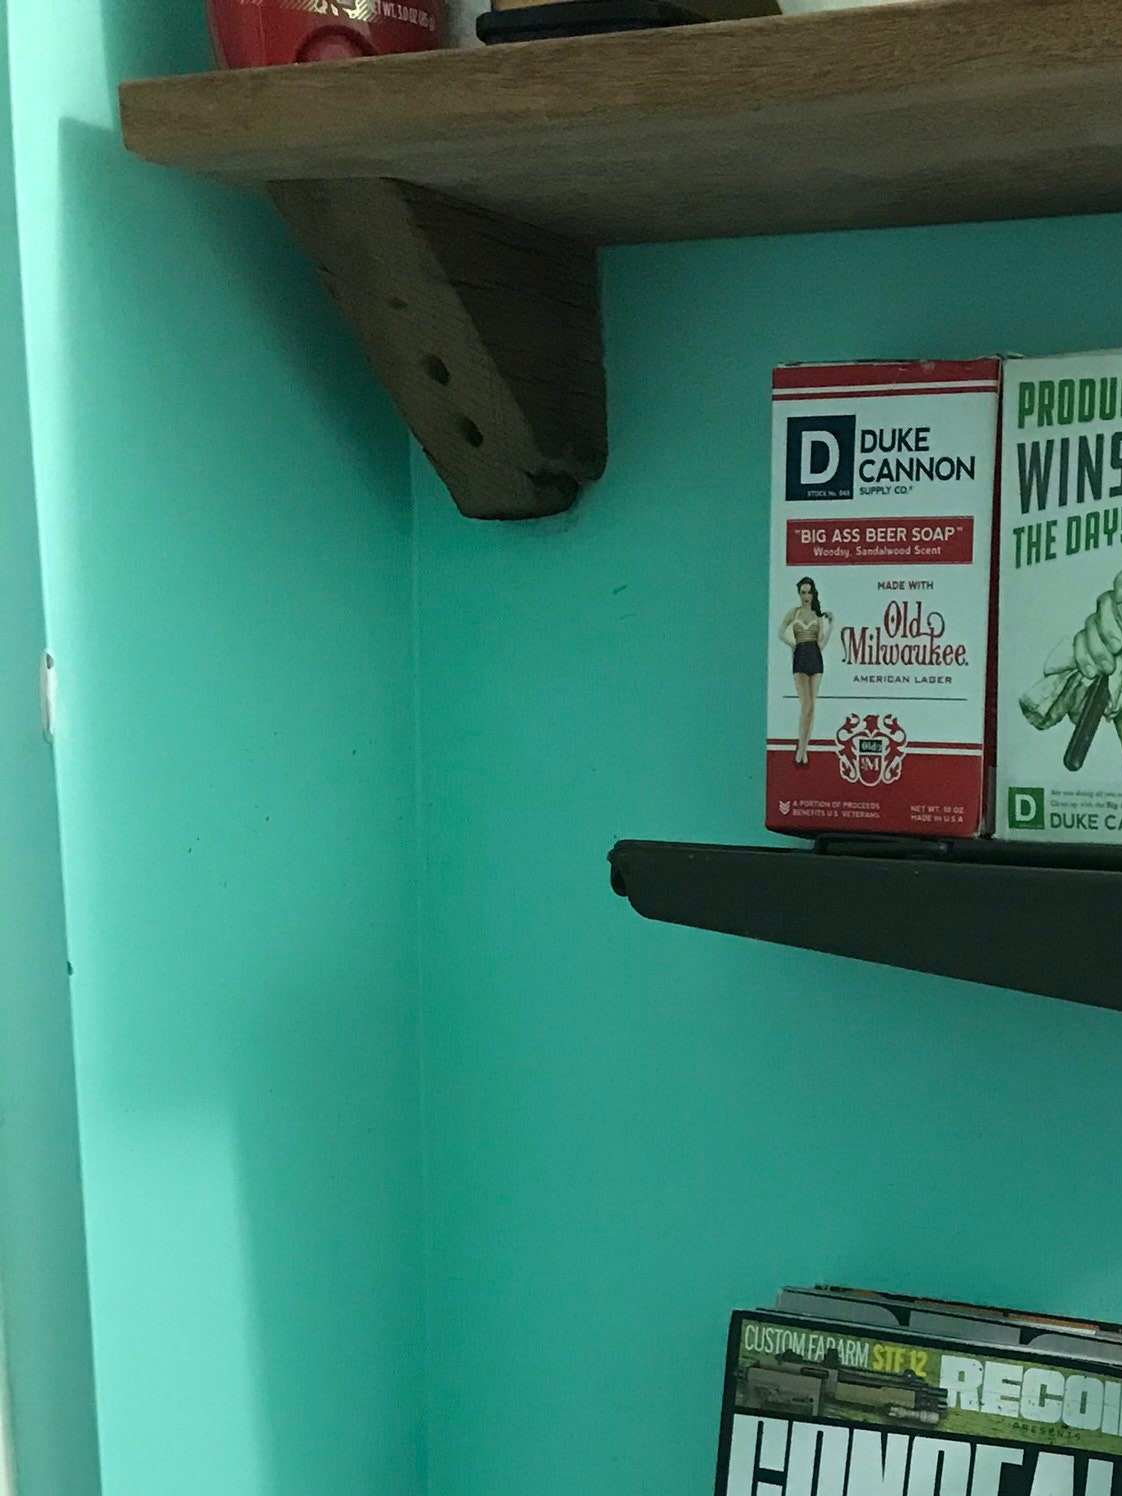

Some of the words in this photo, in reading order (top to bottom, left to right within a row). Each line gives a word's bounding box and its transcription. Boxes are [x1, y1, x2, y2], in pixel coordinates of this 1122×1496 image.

[860, 427, 931, 454] DUKE
[801, 430, 840, 485] D
[858, 455, 976, 483] CANNON
[859, 486, 891, 496] SUPPLY
[832, 528, 861, 543] ASS
[866, 527, 908, 542] BEER
[856, 545, 911, 557] Sandalwood
[914, 545, 942, 556] Scent
[1013, 519, 1058, 569] THE
[877, 581, 906, 590] MADE
[908, 580, 934, 590] WITH
[884, 600, 945, 639] Old
[853, 675, 910, 684] AMERICAN
[914, 676, 953, 685] LAGER
[792, 809, 826, 817] BENEFITS
[799, 801, 830, 809] PORTION
[832, 801, 842, 809] OF
[843, 802, 880, 810] PROCEEDS
[911, 805, 925, 813] NET
[1015, 793, 1037, 823] D
[911, 814, 932, 822] MADE
[1050, 812, 1099, 830] DUKE
[744, 1323, 807, 1359] CUSTOM
[908, 1349, 928, 1378] 12
